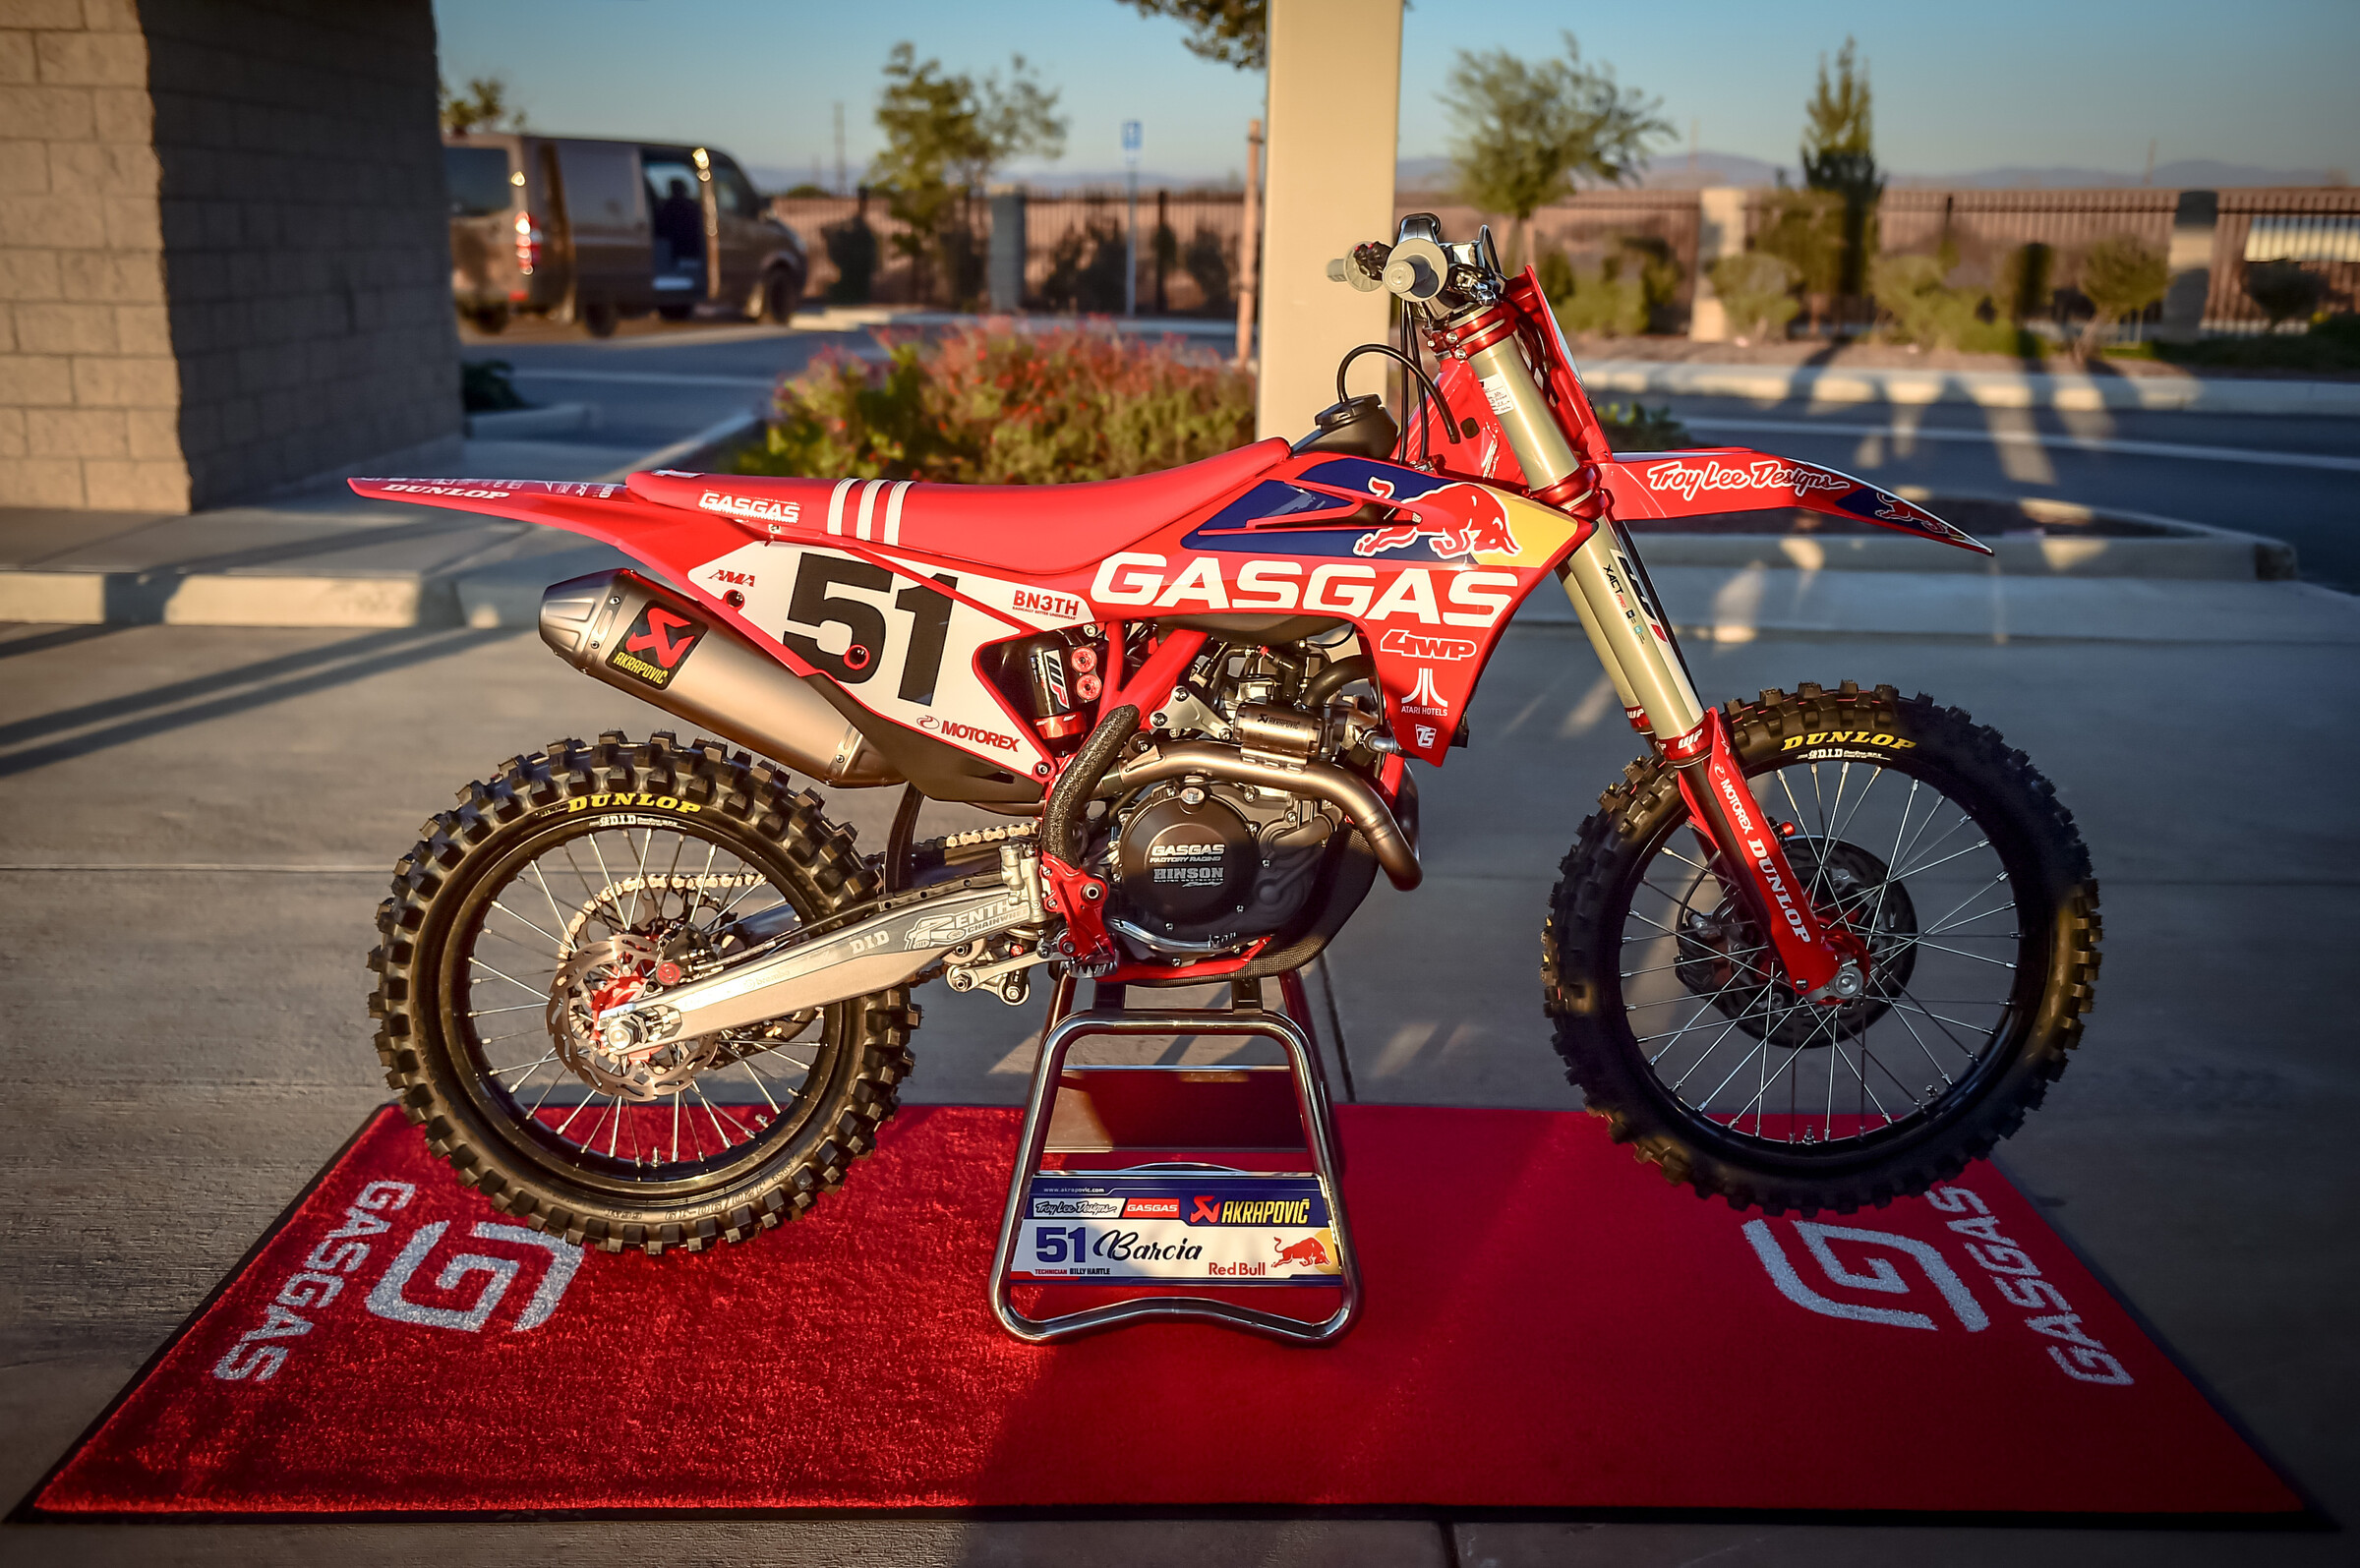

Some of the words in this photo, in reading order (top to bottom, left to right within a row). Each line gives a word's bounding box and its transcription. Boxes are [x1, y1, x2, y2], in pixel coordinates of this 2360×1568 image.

[381, 484, 510, 499] DUNLOP
[1647, 461, 1702, 501] Troy
[1701, 461, 1750, 490] Lee
[1750, 460, 1850, 496] Designs
[699, 492, 800, 523] GASGAS
[708, 569, 756, 587] AMA
[1090, 552, 1522, 628] GASGAS
[1603, 563, 1624, 593] XACT
[1013, 590, 1080, 615] BN3TH
[783, 552, 958, 706] 51
[1401, 706, 1421, 715] ATARI
[1422, 707, 1448, 717] HOTELS
[941, 721, 1021, 752] MOTOREX
[1678, 728, 1702, 749] WP
[1780, 730, 1918, 752] DUNLOP
[567, 792, 702, 813] DUNLOP
[1720, 778, 1754, 835] MOTOREX
[1151, 844, 1225, 856] GASGAS
[1153, 867, 1224, 880] HINSON
[1746, 838, 1810, 943] DUNLOP
[1035, 1200, 1059, 1215] Troy
[1058, 1201, 1076, 1213] Lee
[1076, 1200, 1117, 1215] Designs
[1036, 1227, 1086, 1262] 51
[1092, 1230, 1204, 1262] Barcia
[212, 1180, 416, 1381] GASGAS
[1209, 1262, 1236, 1275] Red
[1239, 1261, 1266, 1275] Bull
[1924, 1185, 2134, 1385] GASGAS
